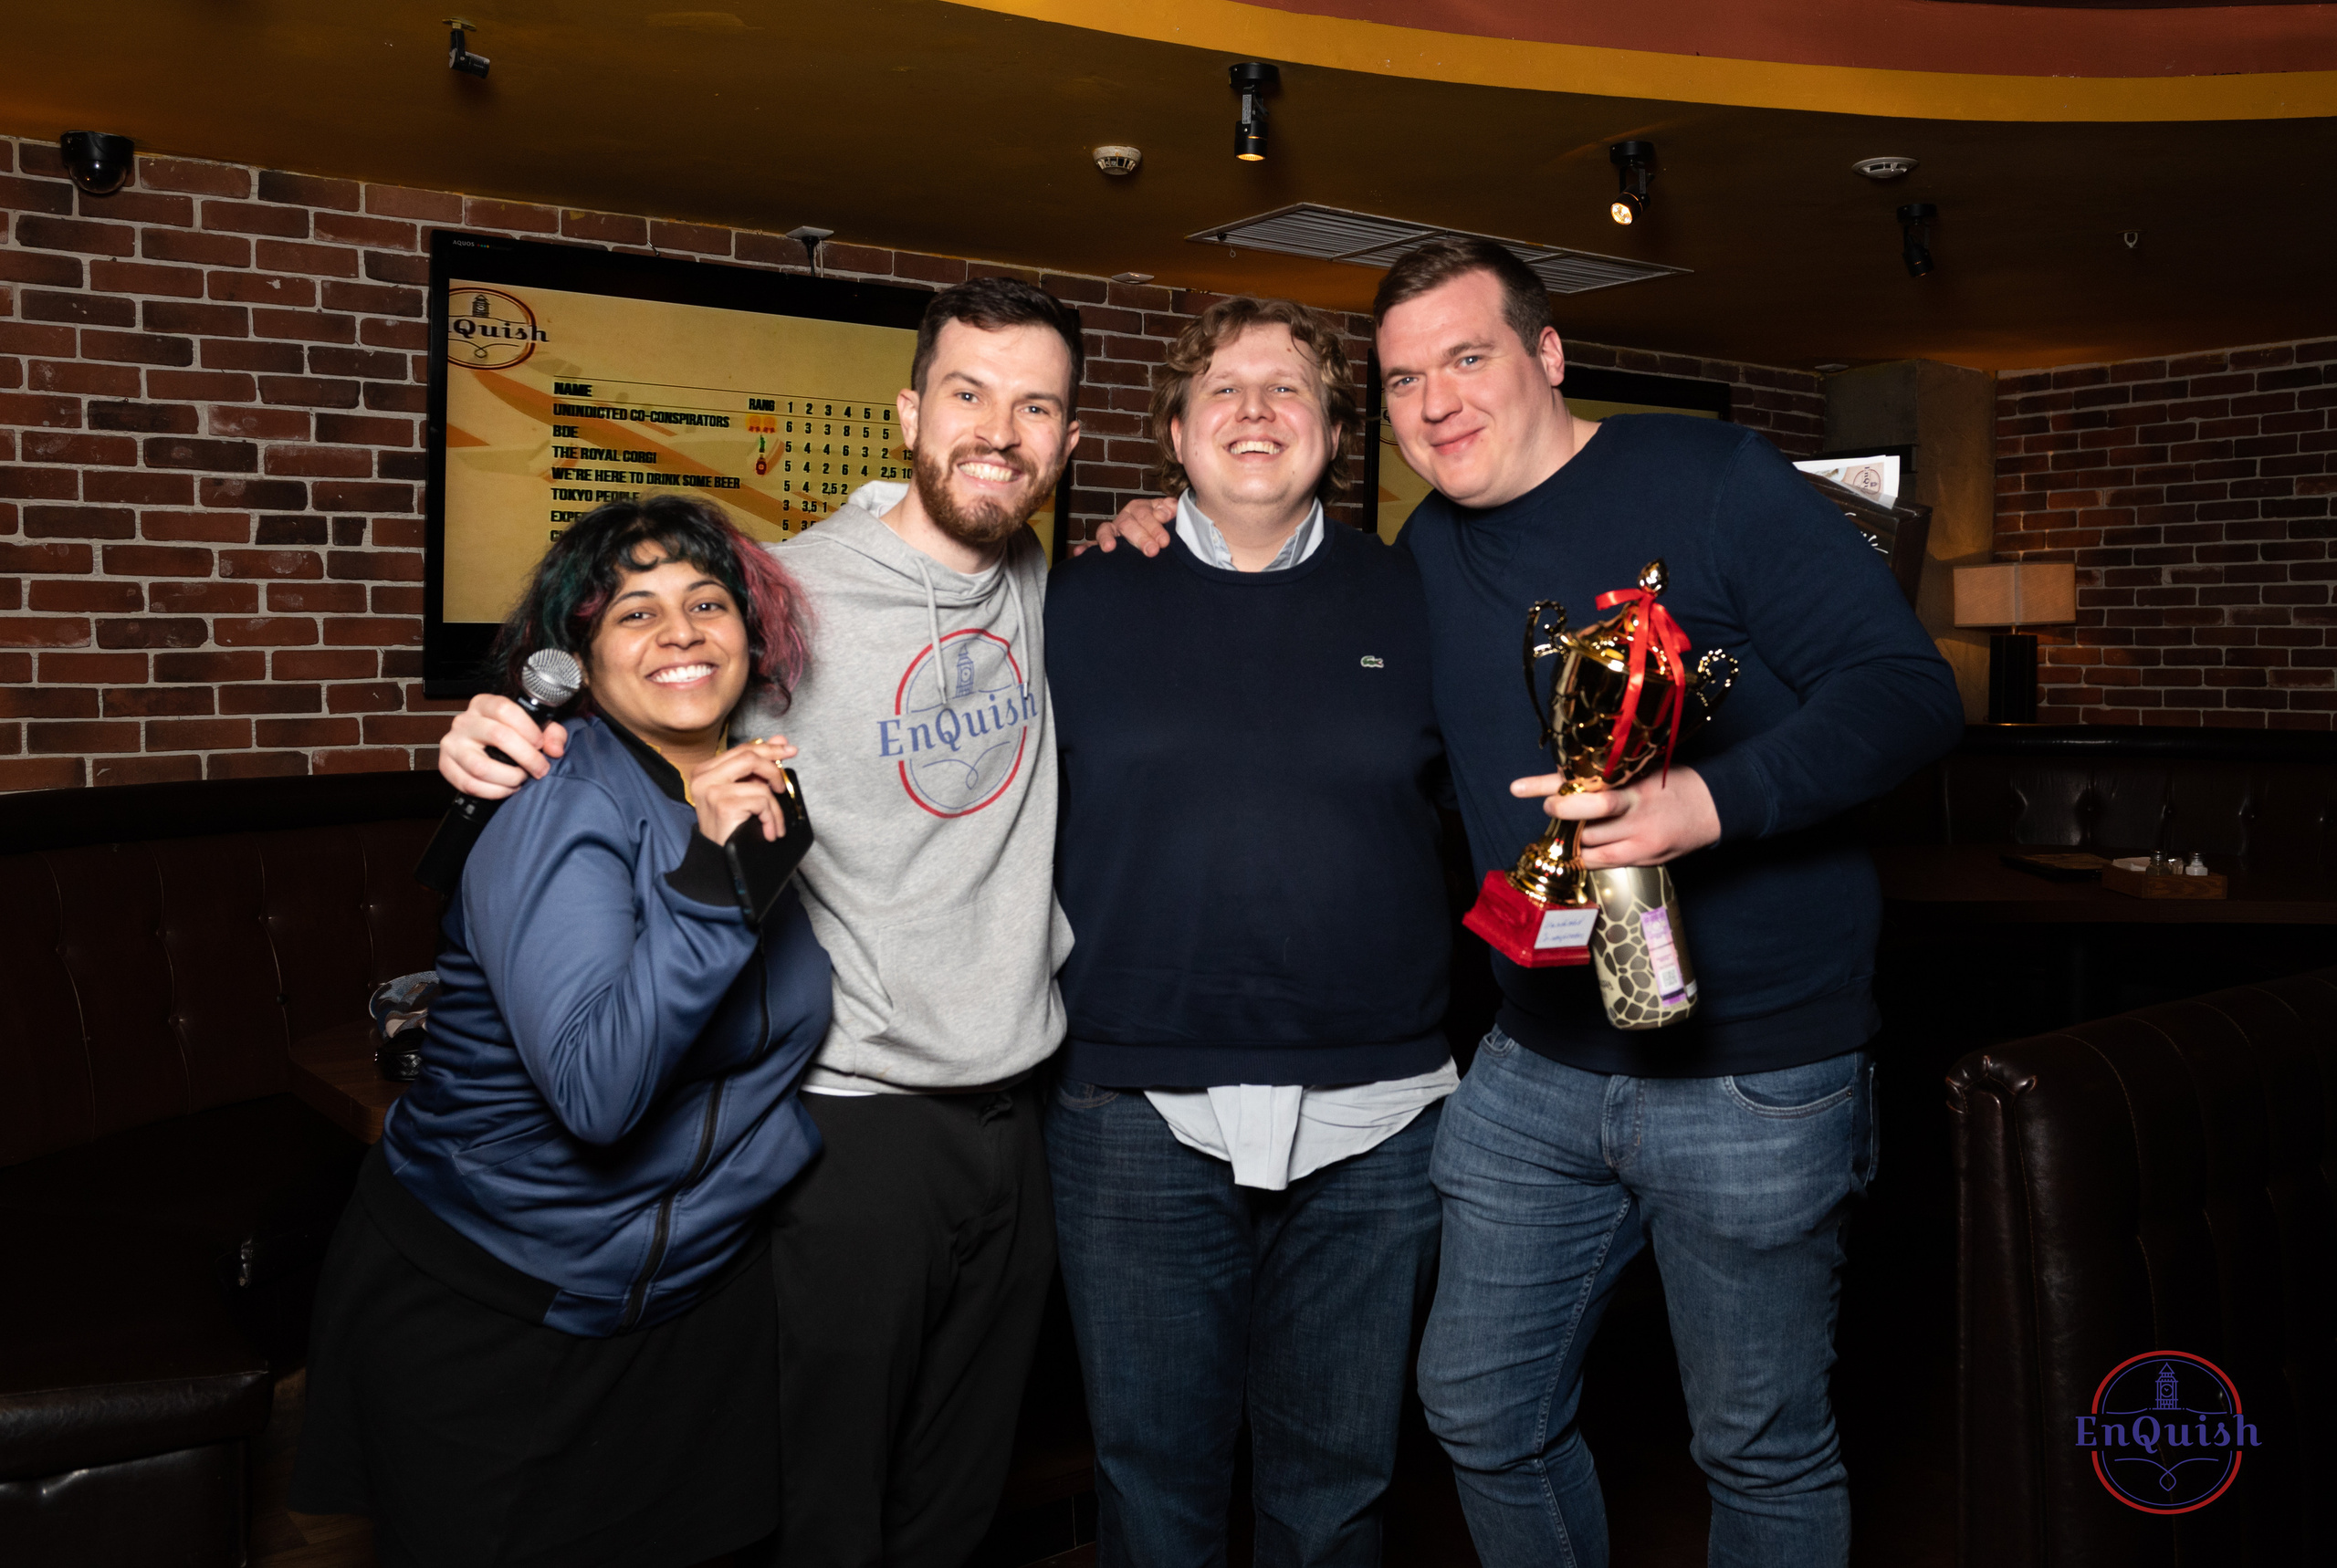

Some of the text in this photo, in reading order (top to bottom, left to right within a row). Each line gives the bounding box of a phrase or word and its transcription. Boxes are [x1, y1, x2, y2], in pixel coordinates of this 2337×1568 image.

[452, 239, 475, 247] AQUOS
[448, 319, 550, 342] Quish
[553, 382, 592, 397] NAME
[788, 402, 793, 413] 1
[806, 402, 813, 414] 2
[824, 404, 833, 416] 3
[844, 406, 851, 418] 4
[864, 407, 871, 420] 5
[884, 409, 891, 422] 6
[553, 402, 889, 440] UNINDICTED CO-CONSPIRATORS 6 3 3 8 5 5
[551, 445, 578, 460] THE
[580, 447, 621, 462] ROYAL
[623, 450, 657, 464] CORGI
[785, 460, 791, 472] 5
[803, 462, 811, 473] 4
[823, 463, 829, 475] 2
[842, 464, 849, 476] 6
[861, 465, 867, 476] 4
[881, 466, 896, 479] 2,5
[785, 440, 792, 453] 5
[803, 442, 811, 455] 4
[823, 444, 831, 455] 4
[842, 445, 849, 456] 6
[862, 446, 869, 458] 3
[882, 447, 889, 459] 2
[551, 467, 848, 496] WE'RE HERE TO DRINK SOME BEER 5 4 2,5 2
[550, 487, 593, 502] TOKYO
[783, 500, 790, 511] 3
[802, 500, 817, 513] 3,5
[823, 502, 827, 513] 1
[782, 519, 789, 531] 5
[876, 684, 1038, 758] EnQuish
